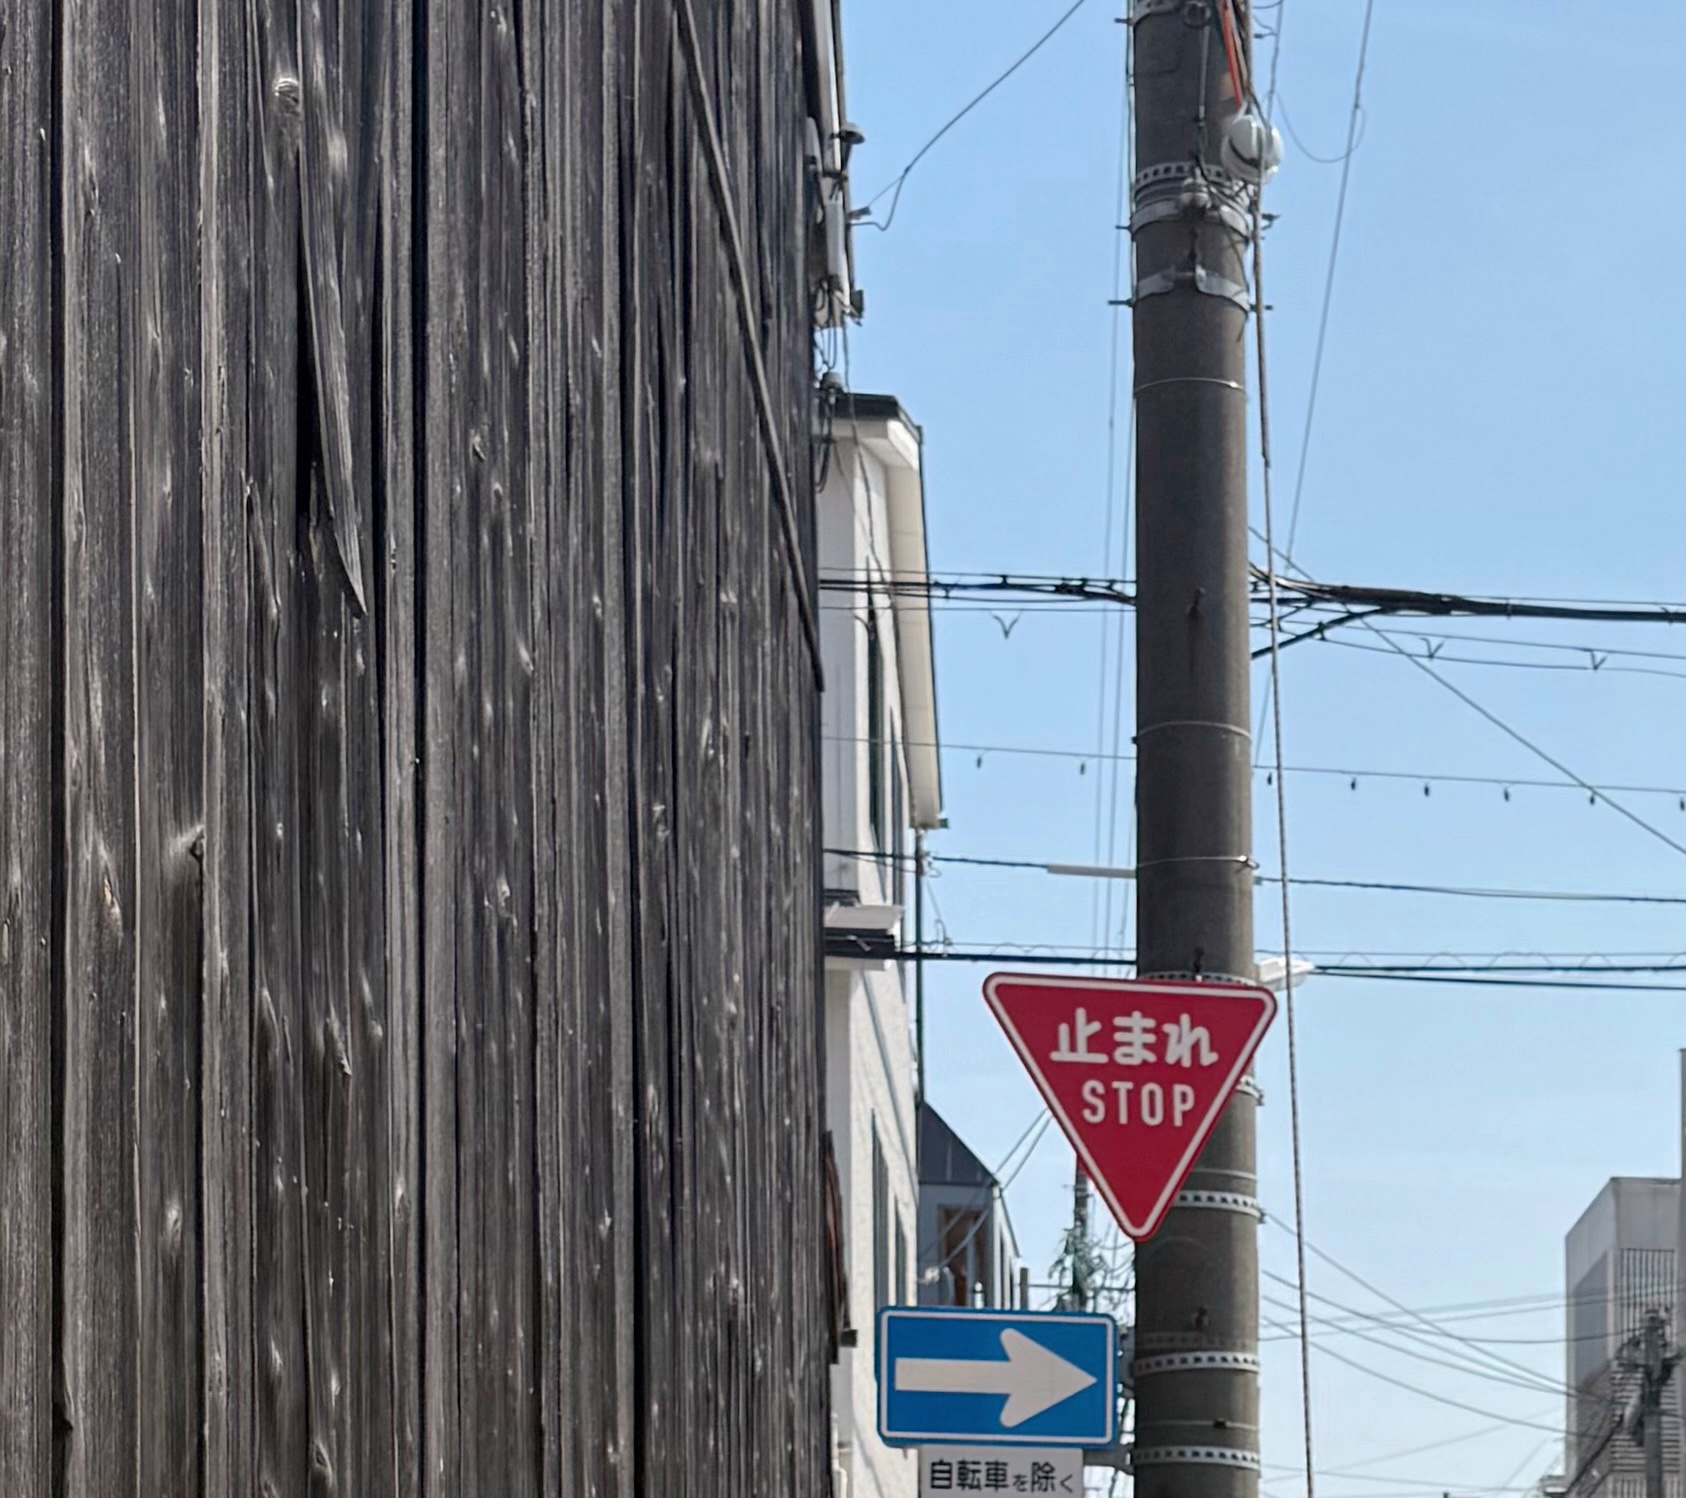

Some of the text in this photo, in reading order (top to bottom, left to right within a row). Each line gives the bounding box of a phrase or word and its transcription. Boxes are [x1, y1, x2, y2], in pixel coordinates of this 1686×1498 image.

[1050, 1007, 1219, 1068] 止まれ
[1082, 1080, 1195, 1127] STOP
[930, 1459, 1073, 1494] 自転車を除く
